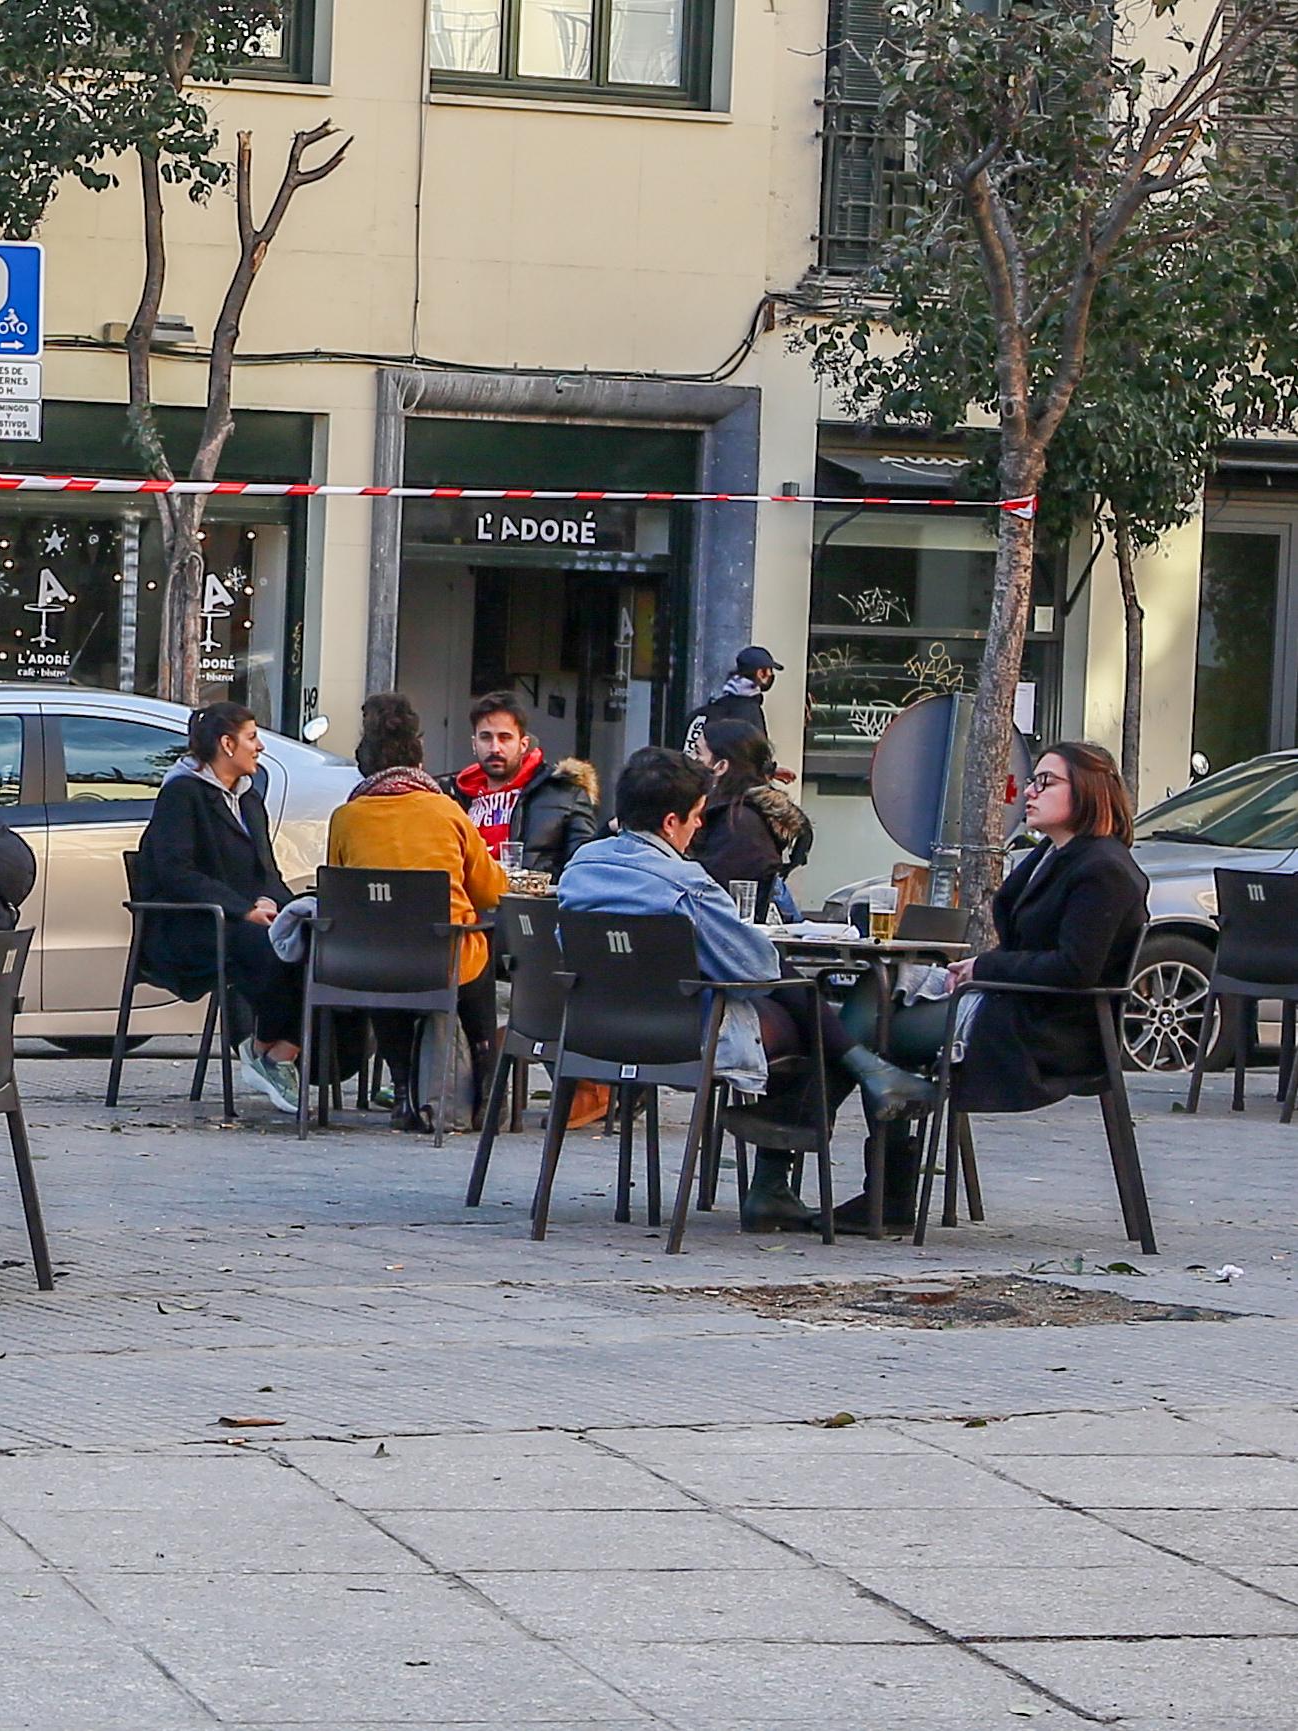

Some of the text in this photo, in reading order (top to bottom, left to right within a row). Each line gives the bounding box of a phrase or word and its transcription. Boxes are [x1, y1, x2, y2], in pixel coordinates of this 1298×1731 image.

[12, 366, 23, 376] DE
[6, 387, 16, 396] H.
[5, 412, 12, 421] Y
[4, 429, 11, 437] A
[17, 649, 71, 666] L'ADORÉ
